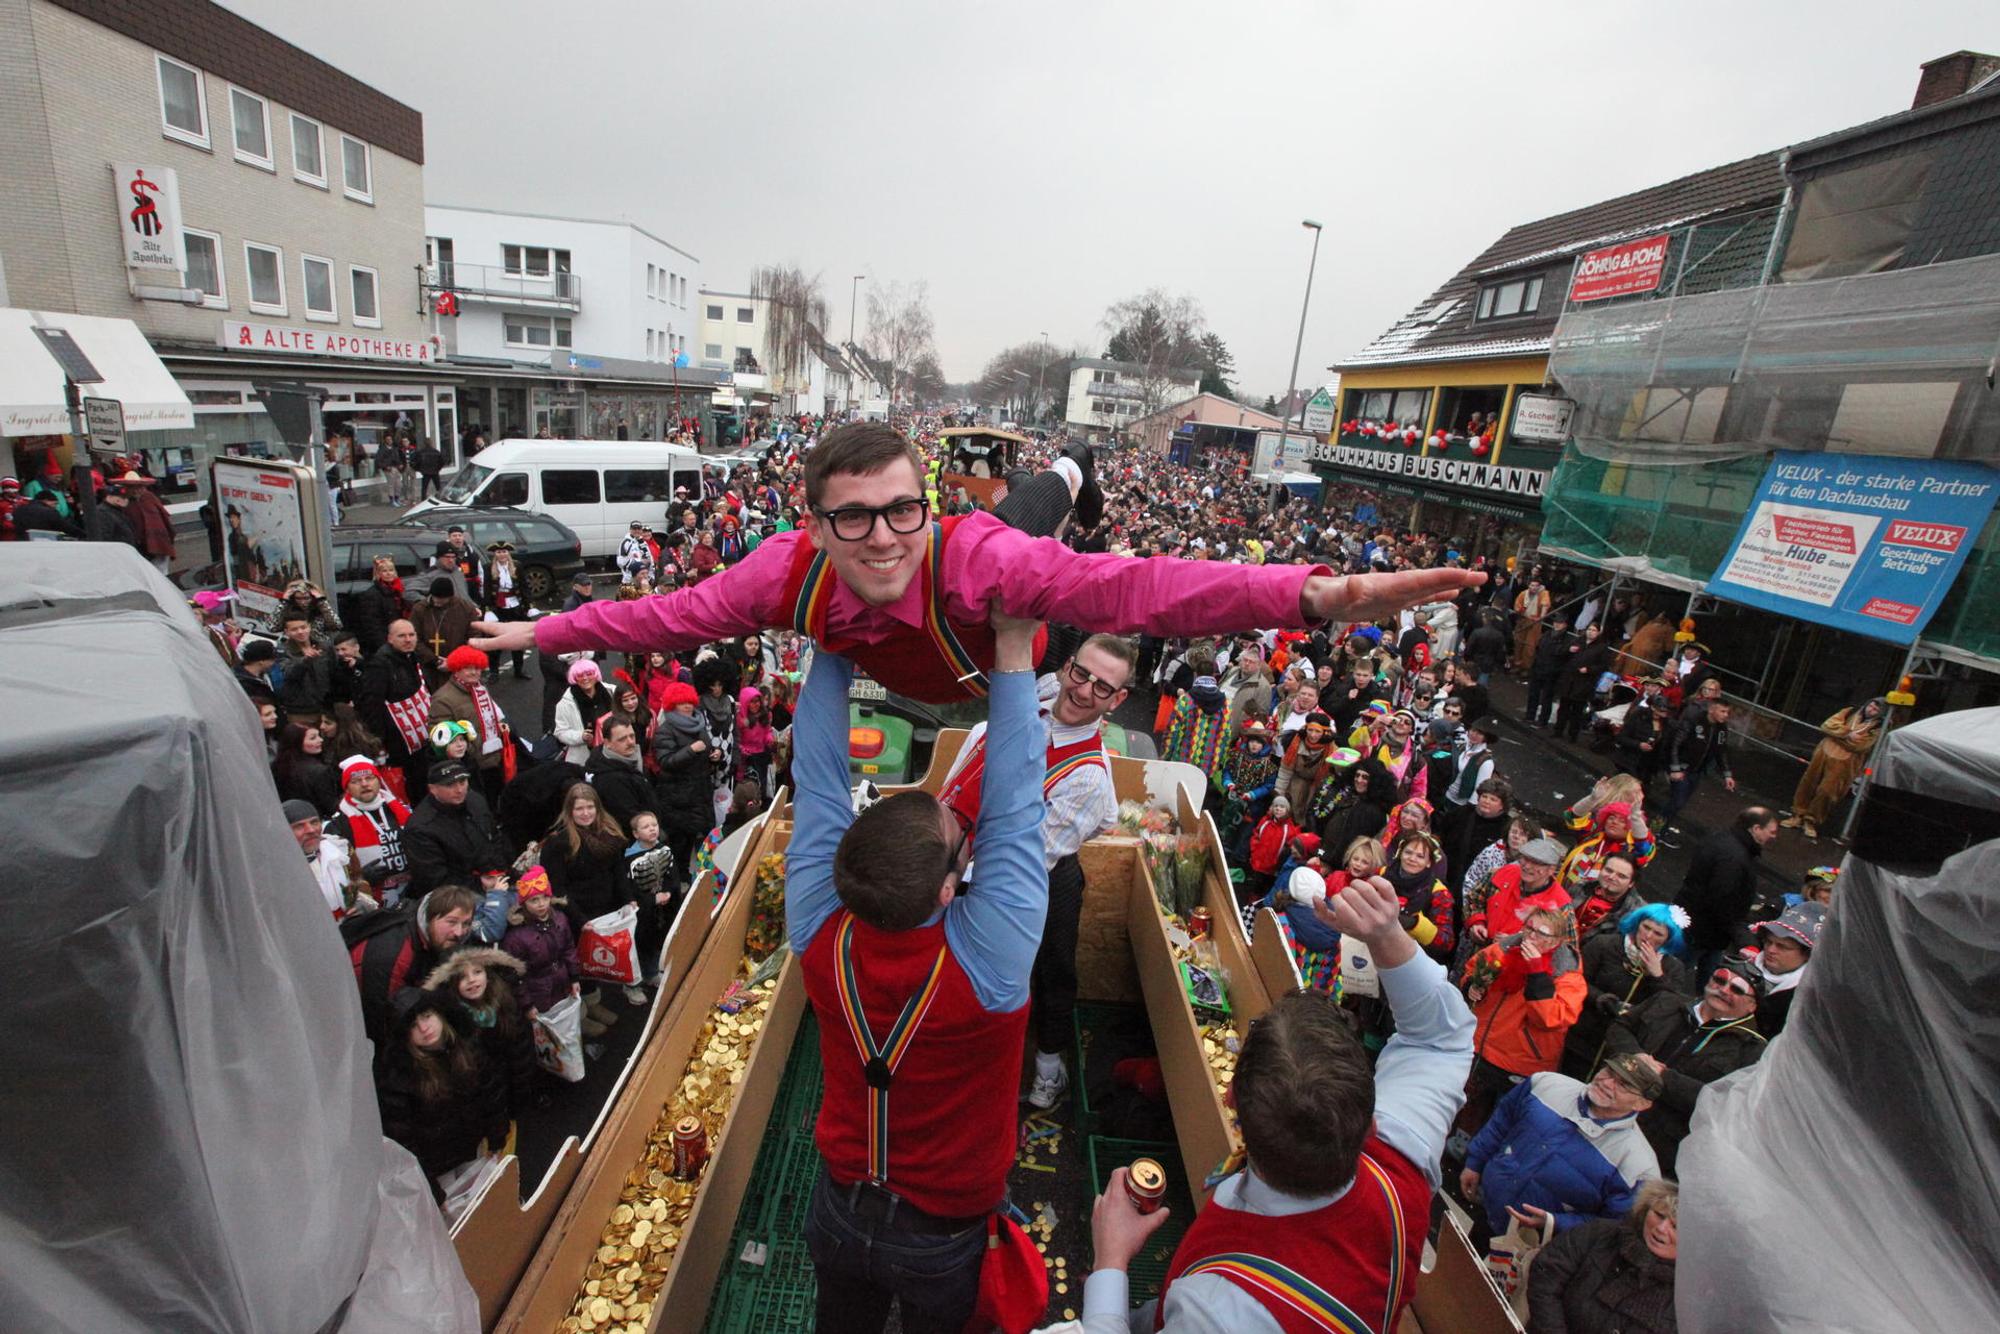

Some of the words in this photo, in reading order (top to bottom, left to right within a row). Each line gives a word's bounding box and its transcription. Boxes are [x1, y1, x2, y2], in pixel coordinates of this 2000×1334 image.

[264, 329, 314, 350] ALTE
[326, 336, 412, 358] APOTHEKE
[1314, 444, 1397, 470] SCHUHHAUS
[1404, 456, 1544, 494] BUSCHMANN
[1776, 464, 1824, 483] VELUX
[1836, 470, 1863, 487] der
[1866, 474, 1916, 491] starke
[1919, 477, 1990, 497] Partner
[1768, 482, 1786, 496] für
[1790, 484, 1816, 501] den
[1819, 488, 1910, 511] Dachausbau
[1785, 544, 1828, 564] Hube
[1879, 546, 1945, 565] Geschulter
[1881, 558, 1928, 575] Betrieb
